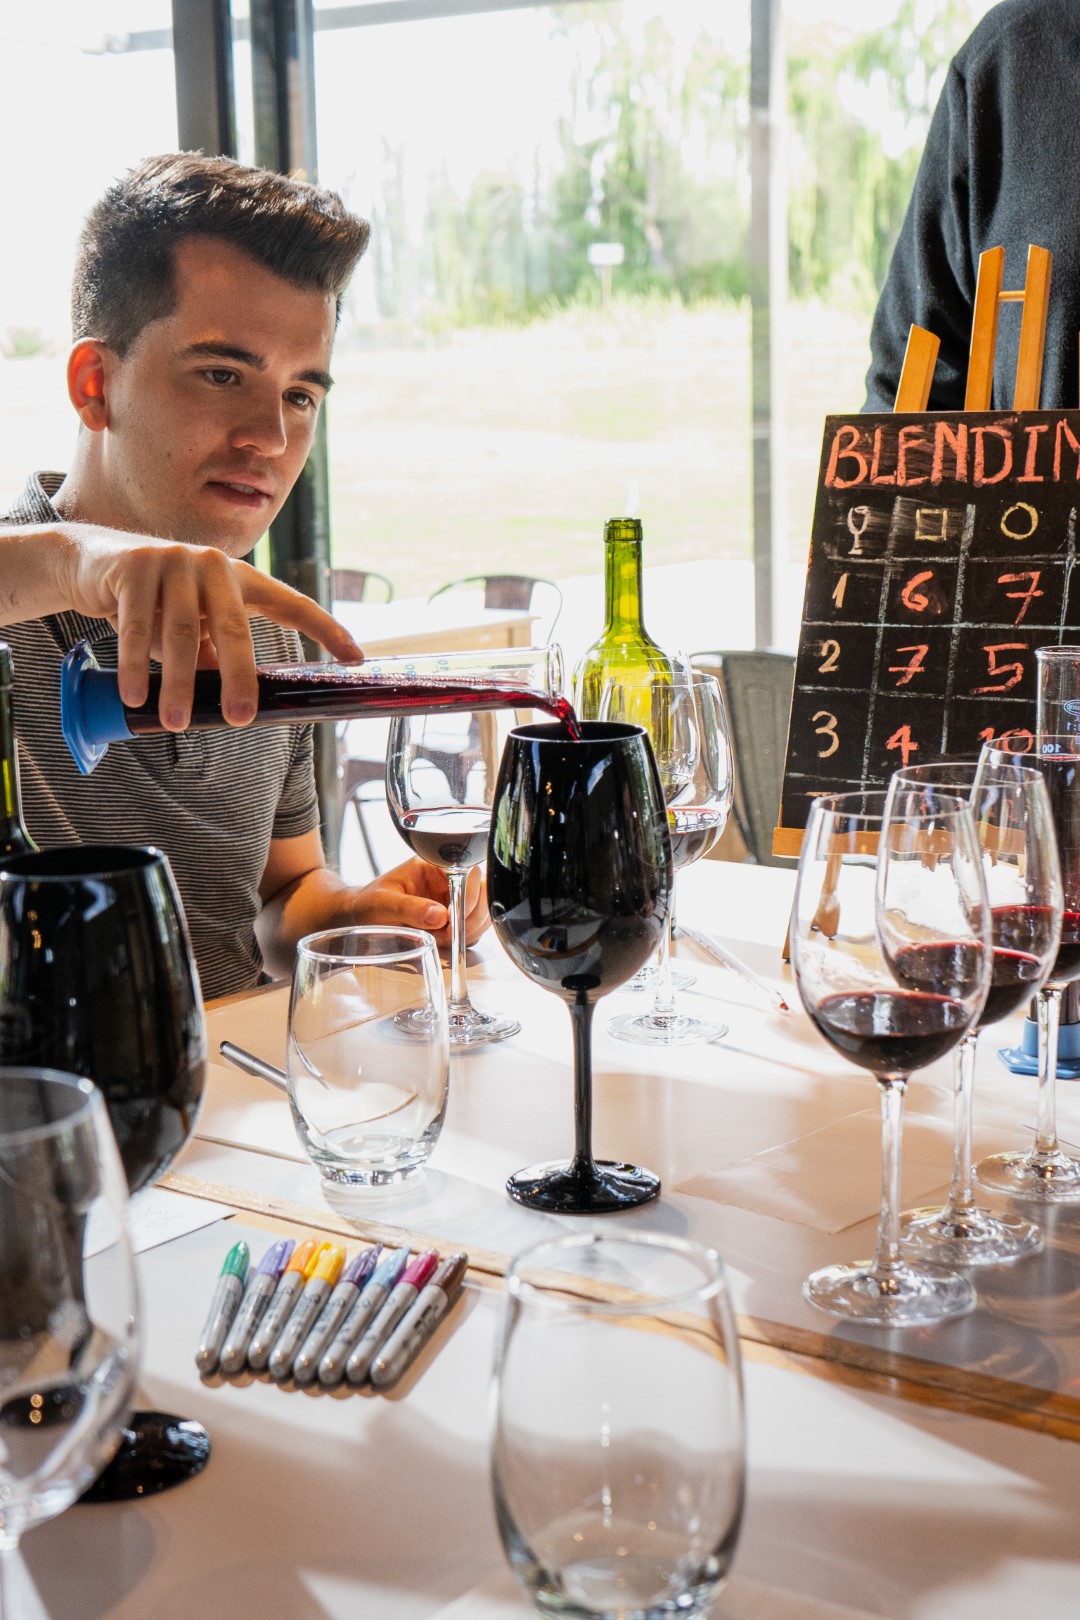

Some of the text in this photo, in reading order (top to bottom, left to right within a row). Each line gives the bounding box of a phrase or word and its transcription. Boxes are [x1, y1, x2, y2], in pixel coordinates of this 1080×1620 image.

[831, 571, 1044, 627] 1 6 7
[818, 640, 1030, 695] 2 7 5
[812, 711, 840, 758] 3
[886, 724, 919, 769] 4
